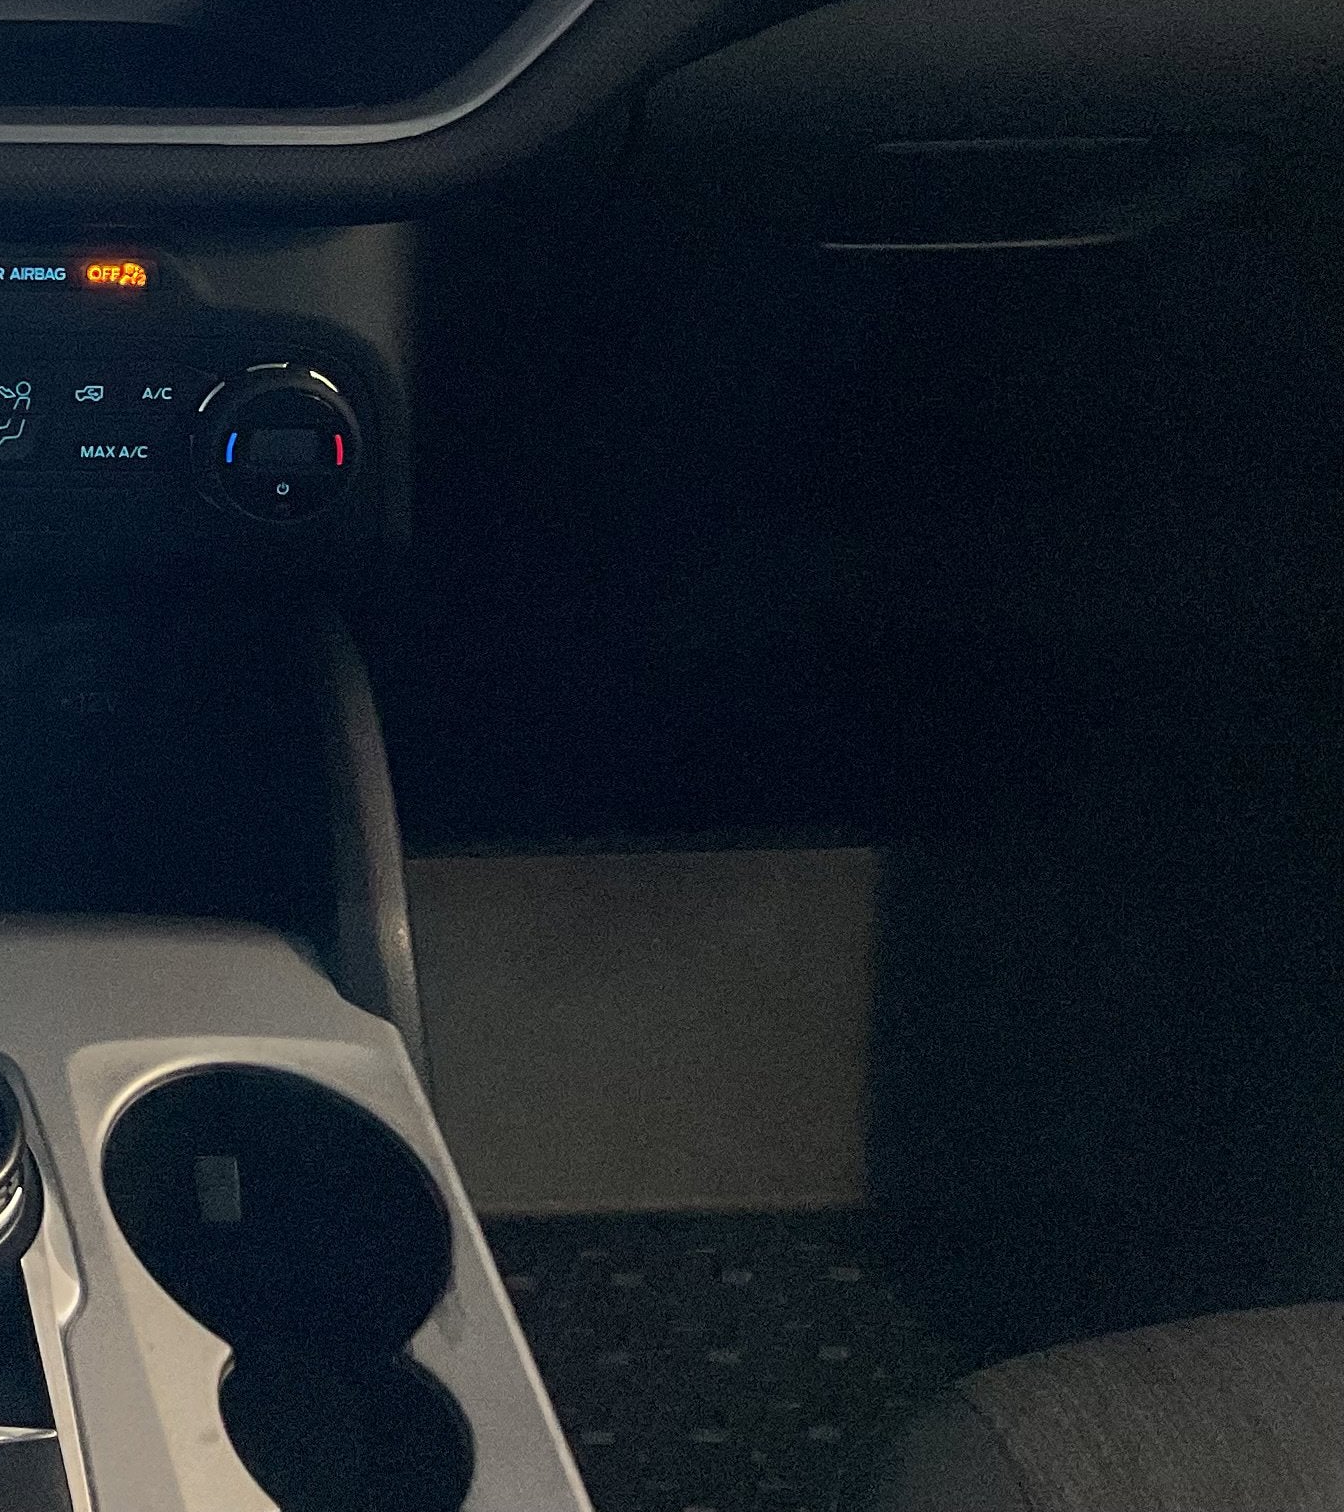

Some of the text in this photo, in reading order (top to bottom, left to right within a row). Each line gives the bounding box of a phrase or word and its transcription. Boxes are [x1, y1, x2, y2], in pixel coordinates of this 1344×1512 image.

[10, 267, 66, 280] AIRBAG
[88, 264, 120, 282] OFF
[142, 388, 172, 399] A/C
[81, 446, 148, 458] MAX A/C
